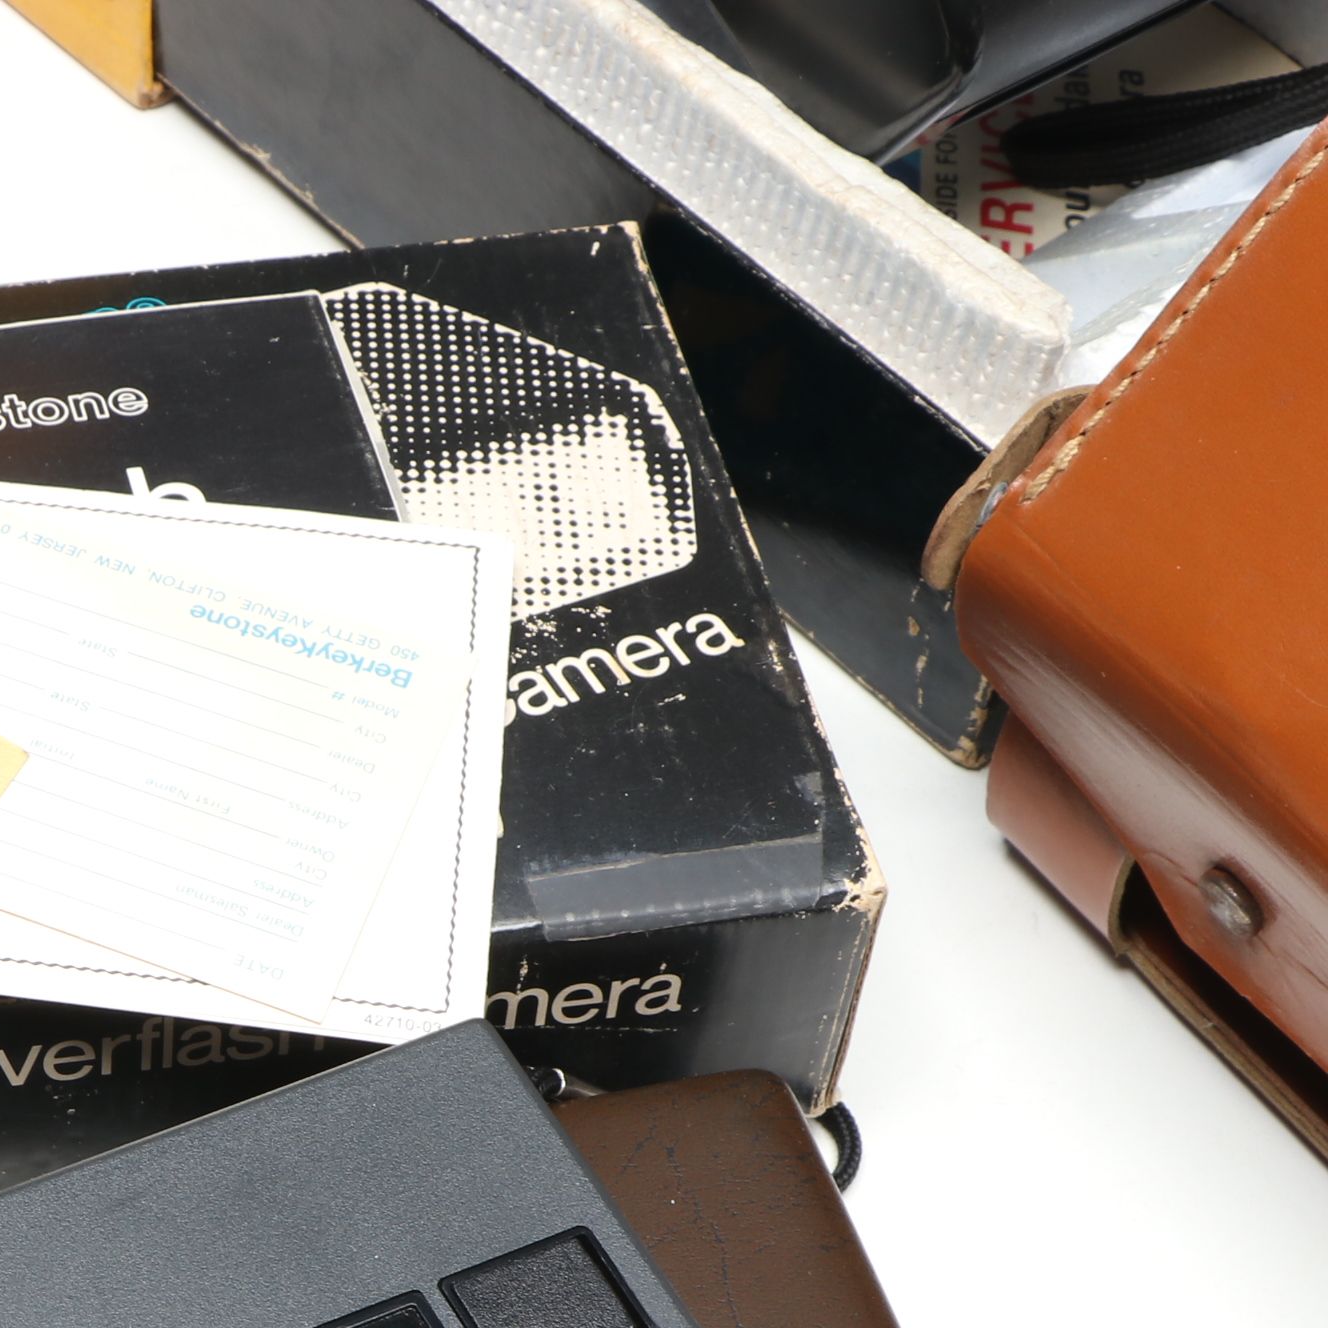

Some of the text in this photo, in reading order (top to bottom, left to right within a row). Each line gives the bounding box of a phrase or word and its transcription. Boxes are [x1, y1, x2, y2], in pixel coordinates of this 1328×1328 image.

[18, 530, 87, 559] JERSEY
[94, 555, 136, 576] NEW
[189, 602, 414, 689] BerkeyKeystone
[321, 625, 381, 650] GETTY
[390, 644, 421, 662] 450
[504, 612, 746, 728] amera
[50, 690, 91, 712] State
[78, 638, 387, 744] City State
[352, 695, 401, 719] Model
[328, 750, 376, 774] Dealer
[144, 777, 190, 800] Name
[330, 783, 362, 803] City
[195, 794, 232, 816] First
[288, 800, 352, 830] Address
[285, 837, 335, 863] Owner
[294, 859, 328, 881] City
[253, 878, 317, 908] Address
[175, 882, 305, 937] Dealer Salesman
[233, 953, 285, 981] DATE
[486, 973, 682, 1030] mera
